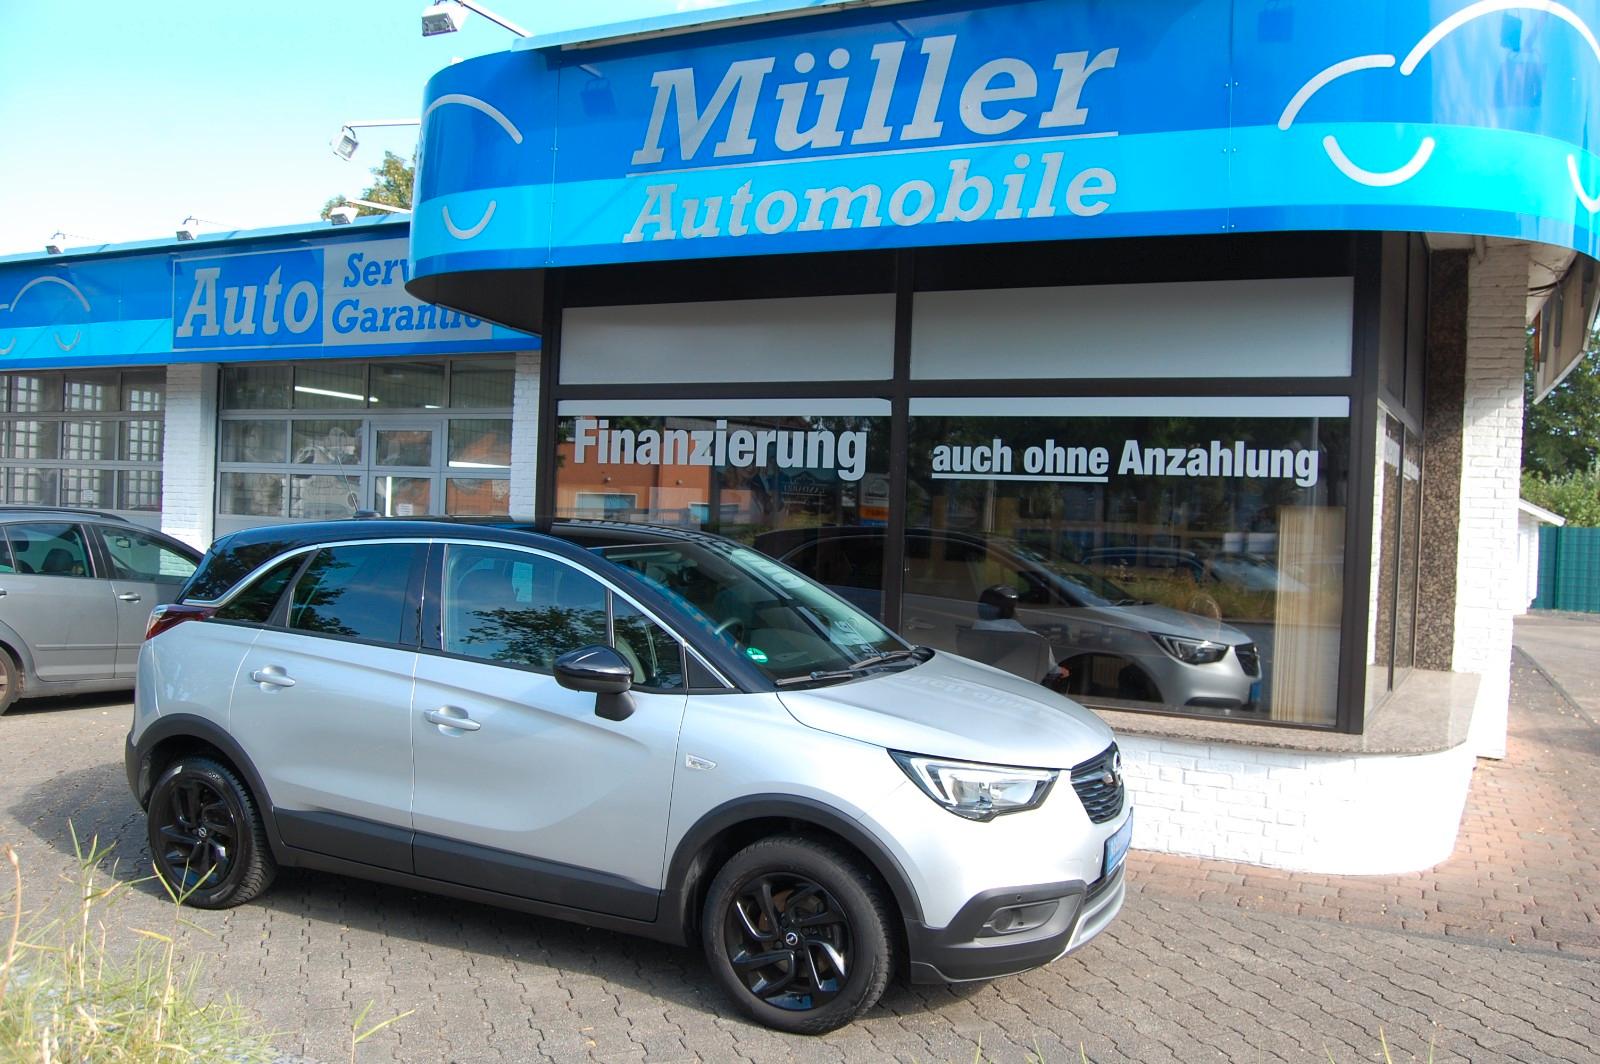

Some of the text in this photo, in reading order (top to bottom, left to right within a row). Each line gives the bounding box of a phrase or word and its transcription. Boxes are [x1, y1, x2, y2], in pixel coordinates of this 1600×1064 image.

[632, 34, 1119, 165] Müller
[622, 151, 1117, 243] Automobile
[177, 265, 319, 338] Auto
[574, 419, 867, 481] Finanzierung
[932, 439, 1319, 487] auch ohne Anzahlung
